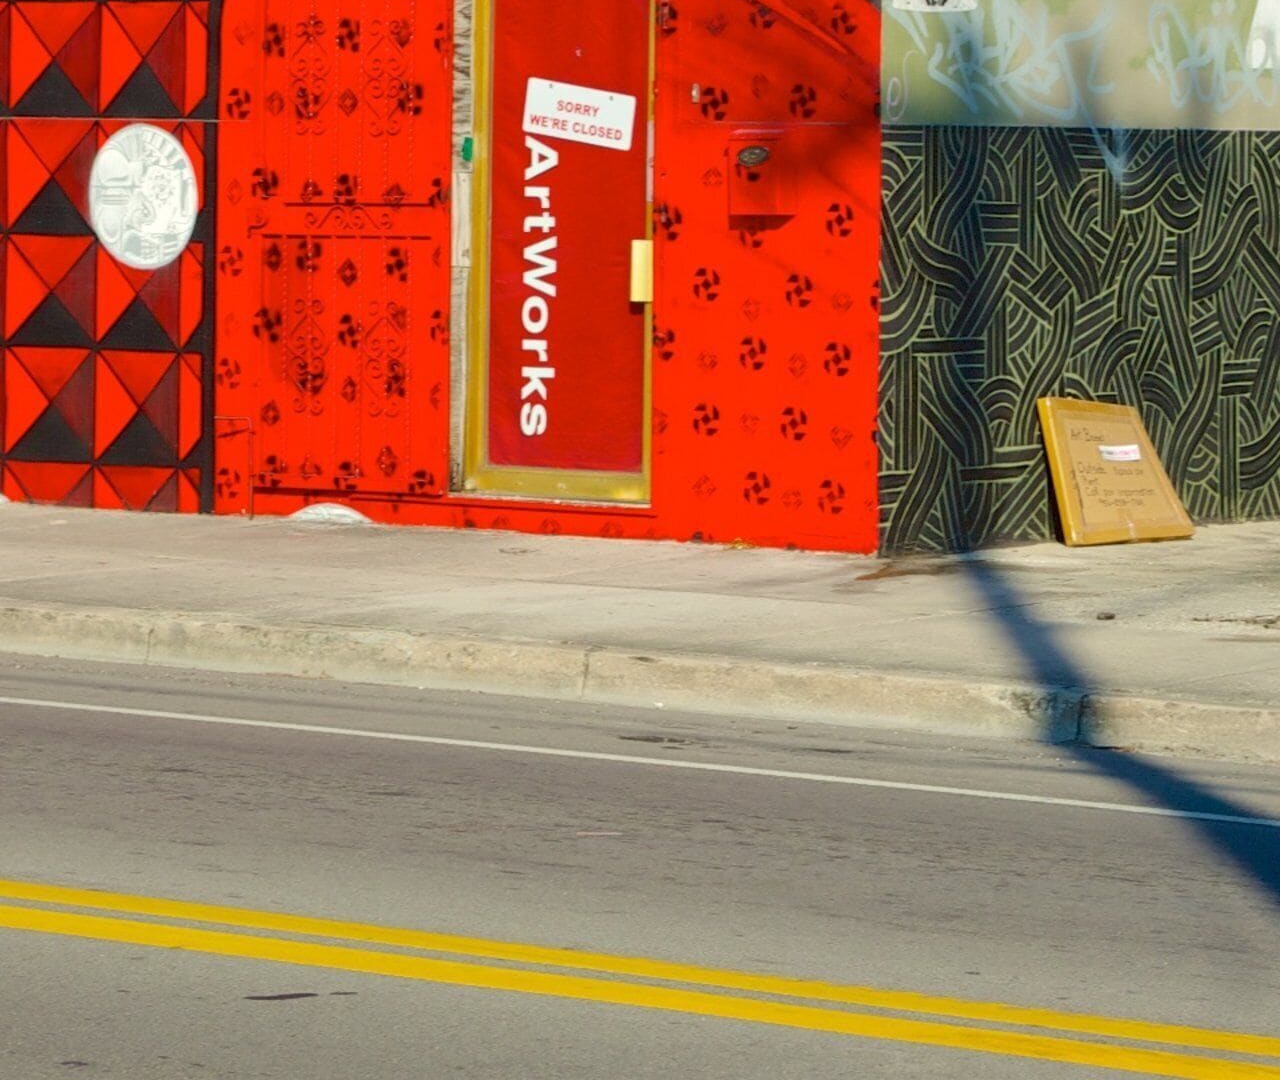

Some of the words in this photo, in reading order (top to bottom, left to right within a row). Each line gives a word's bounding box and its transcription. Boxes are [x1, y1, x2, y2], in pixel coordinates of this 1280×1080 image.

[556, 100, 600, 117] SORRY
[530, 114, 569, 132] WE'RE
[572, 122, 623, 141] CLOSED
[520, 136, 559, 437] ArtWorks
